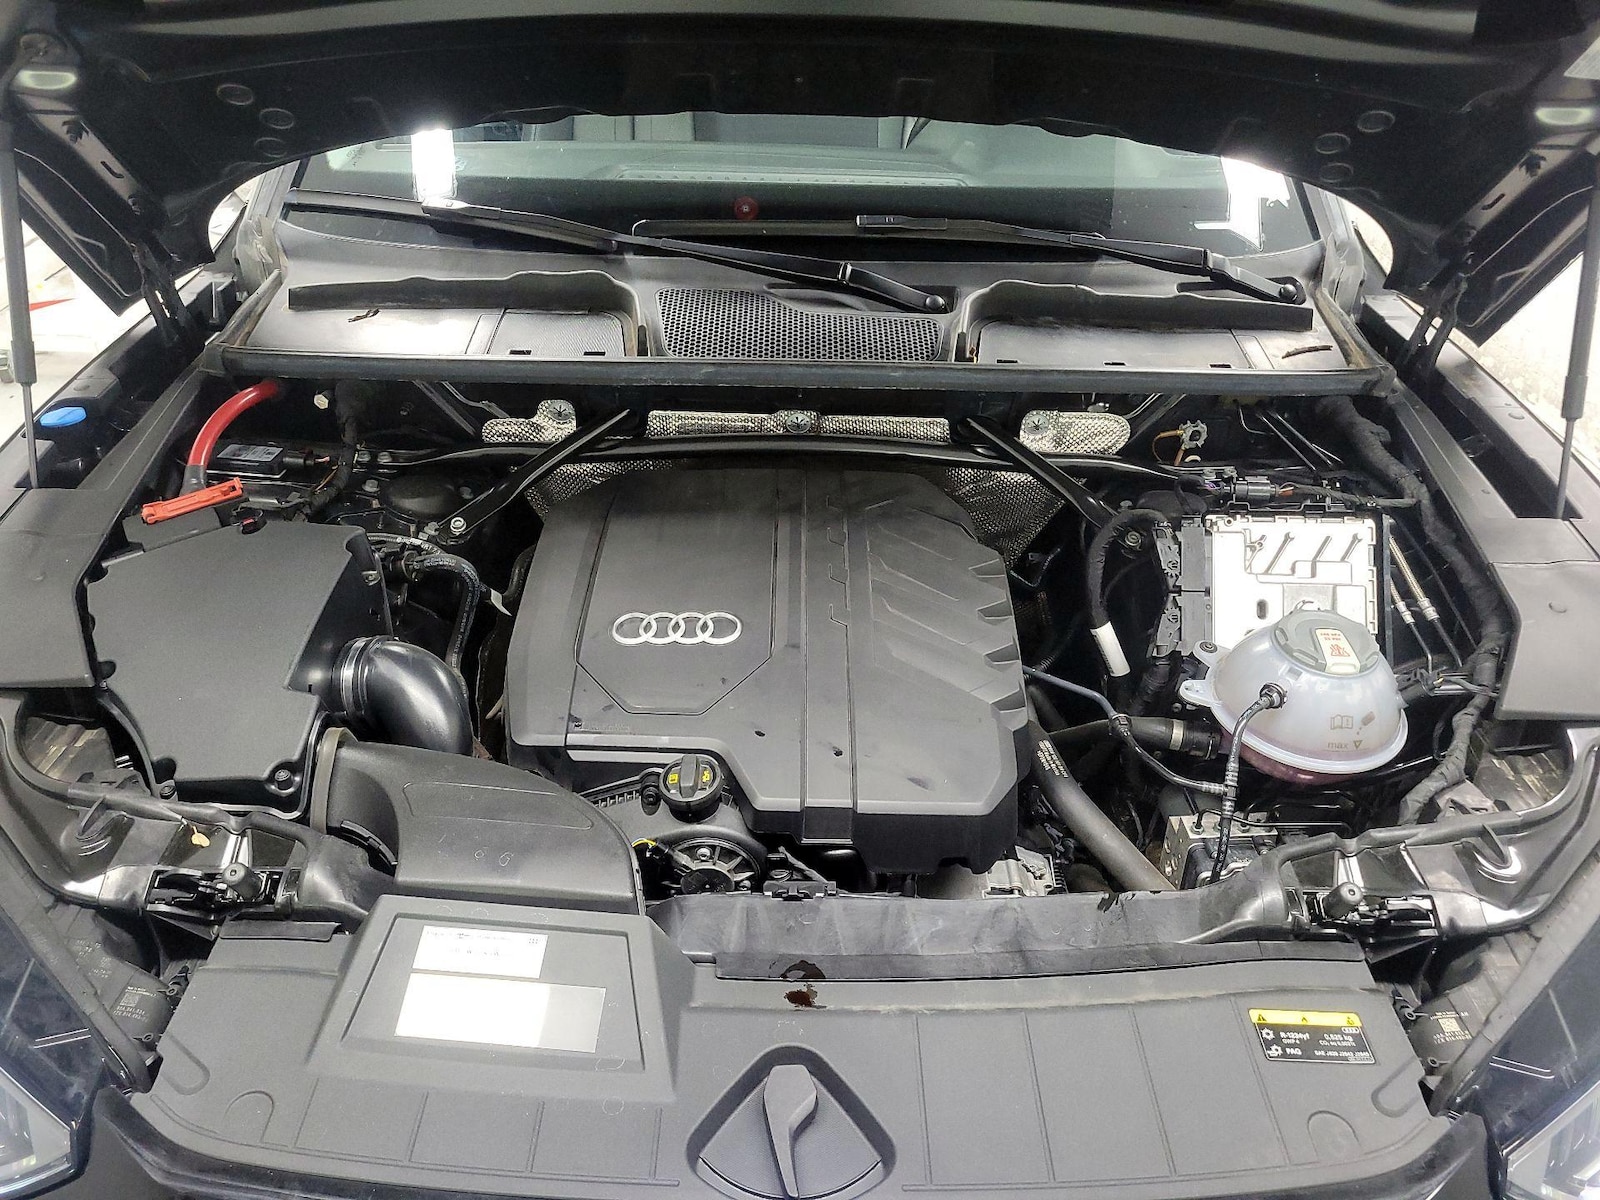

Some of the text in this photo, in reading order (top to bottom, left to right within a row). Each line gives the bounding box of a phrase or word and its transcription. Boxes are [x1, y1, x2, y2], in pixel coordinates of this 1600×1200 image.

[1327, 742, 1349, 750] max
[1343, 1034, 1353, 1042] kg
[1285, 1047, 1303, 1055] PAG
